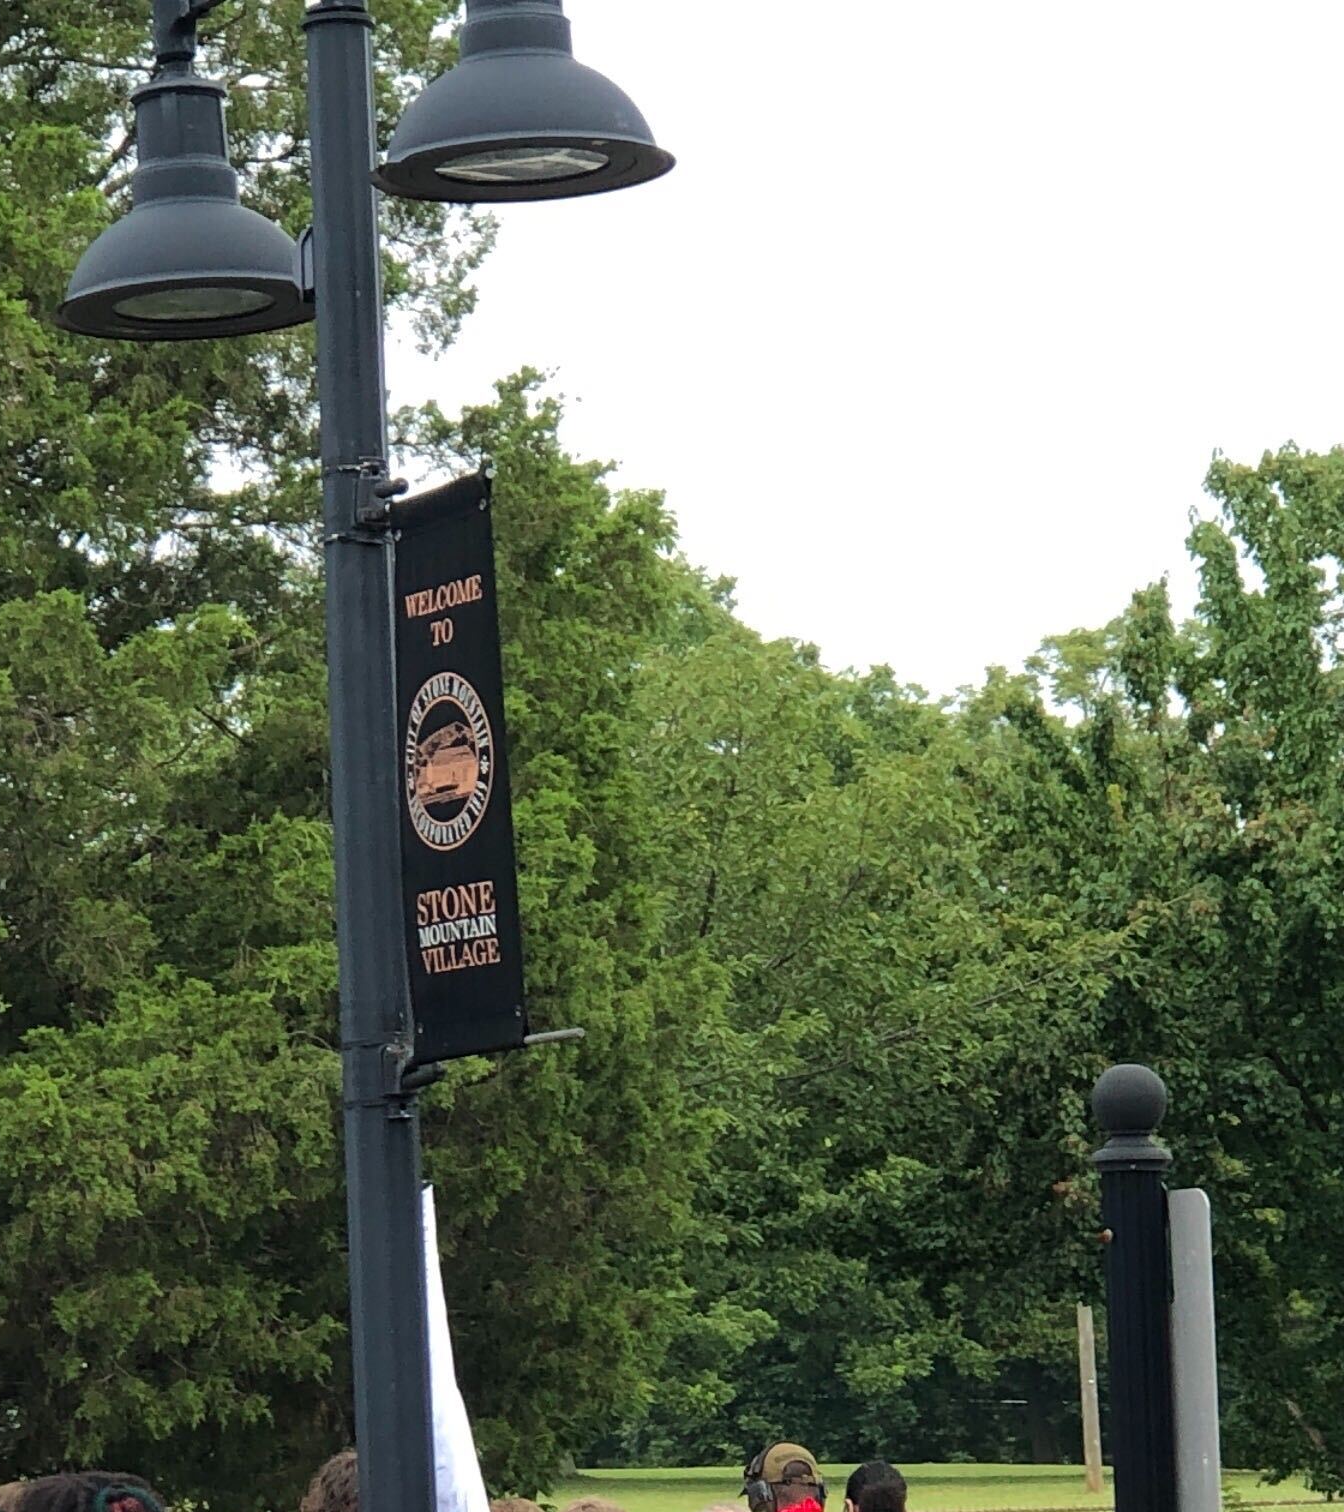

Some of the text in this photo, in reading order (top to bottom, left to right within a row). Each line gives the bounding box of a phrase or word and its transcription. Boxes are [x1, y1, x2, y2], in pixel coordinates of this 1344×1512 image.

[404, 574, 482, 619] WELCOME
[430, 617, 454, 647] TO
[417, 881, 496, 926] STONE
[418, 914, 497, 948] MOUNTAIN
[421, 938, 501, 975] VILLAGE
